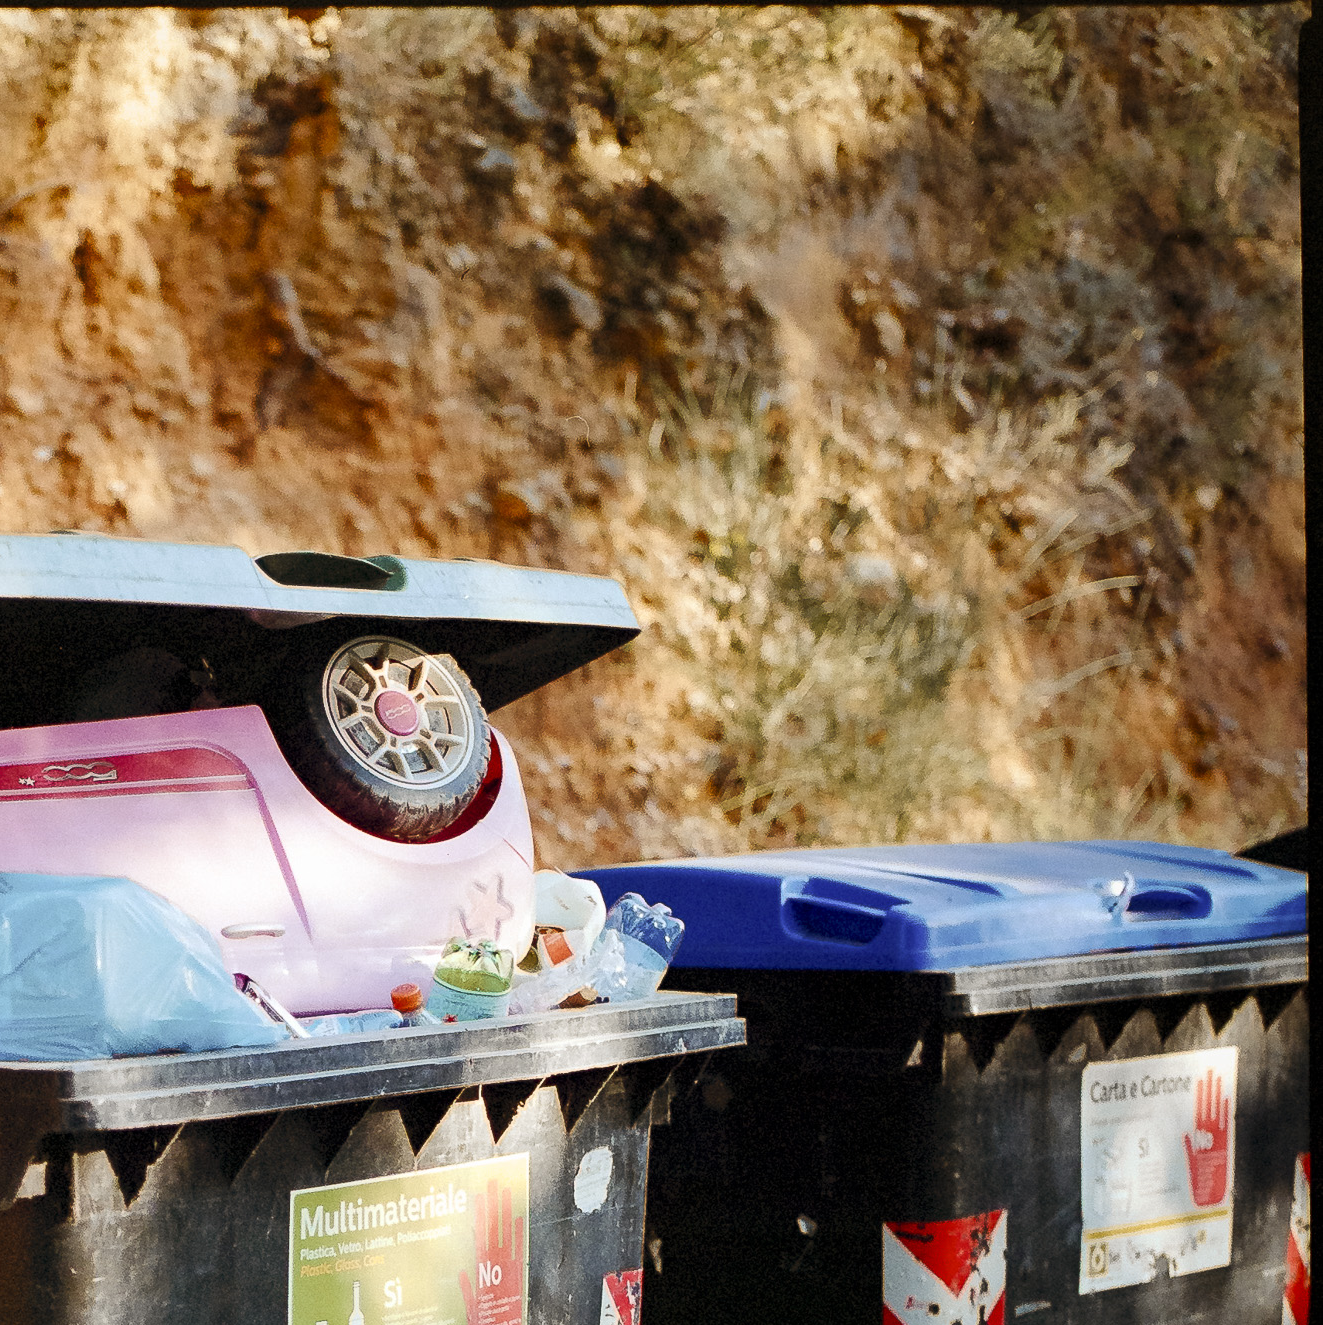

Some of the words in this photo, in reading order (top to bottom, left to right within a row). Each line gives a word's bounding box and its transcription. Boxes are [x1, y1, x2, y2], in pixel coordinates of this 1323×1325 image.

[41, 761, 117, 782] 500
[1090, 1080, 1126, 1103] Carta
[1141, 1075, 1191, 1097] Cartone
[300, 1183, 466, 1240] Multimateriale
[300, 1245, 337, 1262] Plastica,
[338, 1240, 364, 1256] Vetro,
[365, 1234, 397, 1251] Lattine,
[478, 1261, 502, 1289] No
